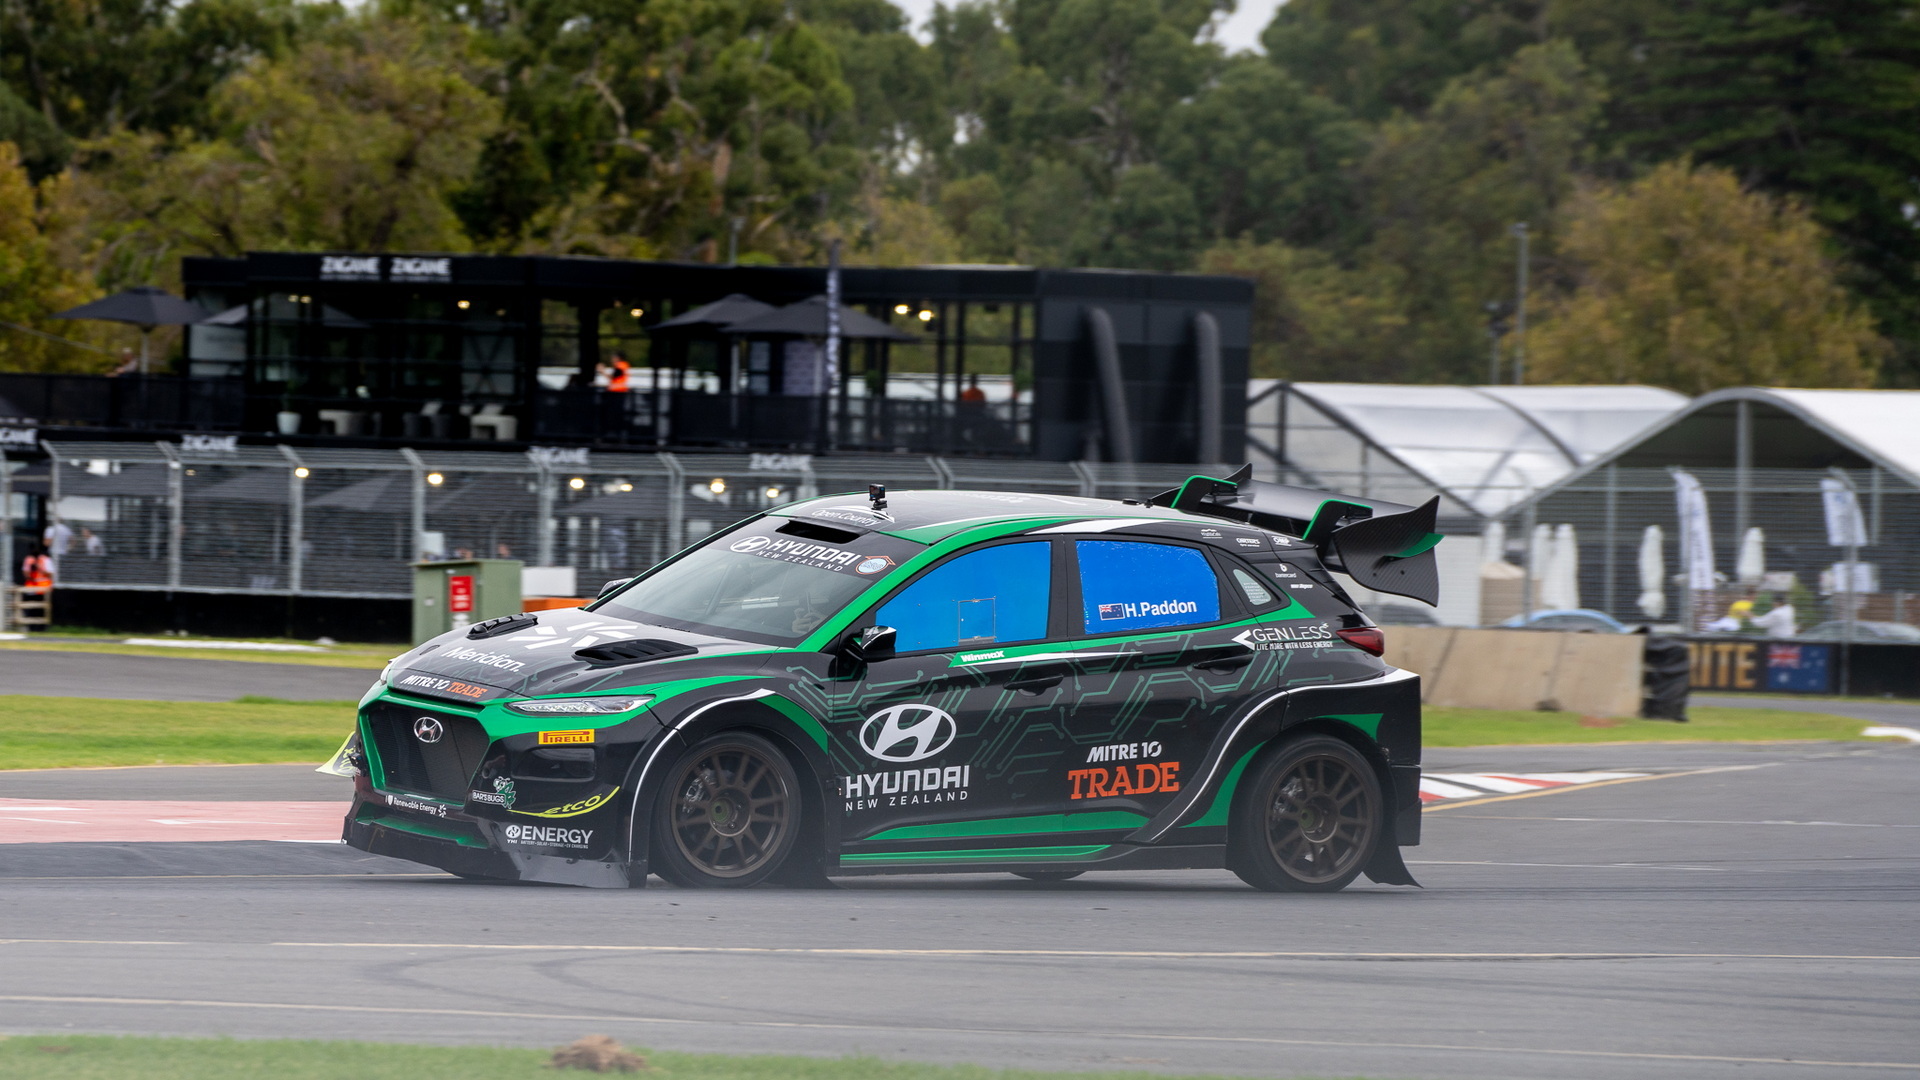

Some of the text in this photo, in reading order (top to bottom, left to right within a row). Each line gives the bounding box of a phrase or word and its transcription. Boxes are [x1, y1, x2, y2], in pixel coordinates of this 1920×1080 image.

[811, 509, 882, 526] Open Country
[756, 550, 843, 572] NEW ZEALAND
[766, 538, 862, 566] HYUNDAI
[1125, 600, 1197, 618] H.Paddon
[1269, 642, 1284, 650] MORE
[441, 646, 526, 673] Meridian.
[400, 675, 437, 688] MITRE
[446, 682, 488, 698] TRADE
[543, 730, 590, 743] PIRELLI
[1086, 741, 1162, 763] MITRE 10
[845, 765, 970, 798] HYUNDAI
[1067, 761, 1180, 800] TRADE
[393, 797, 419, 810] Renewable
[419, 803, 437, 815] Energy
[845, 790, 968, 811] NEW ZEALAND
[521, 825, 594, 844] ENERGY
